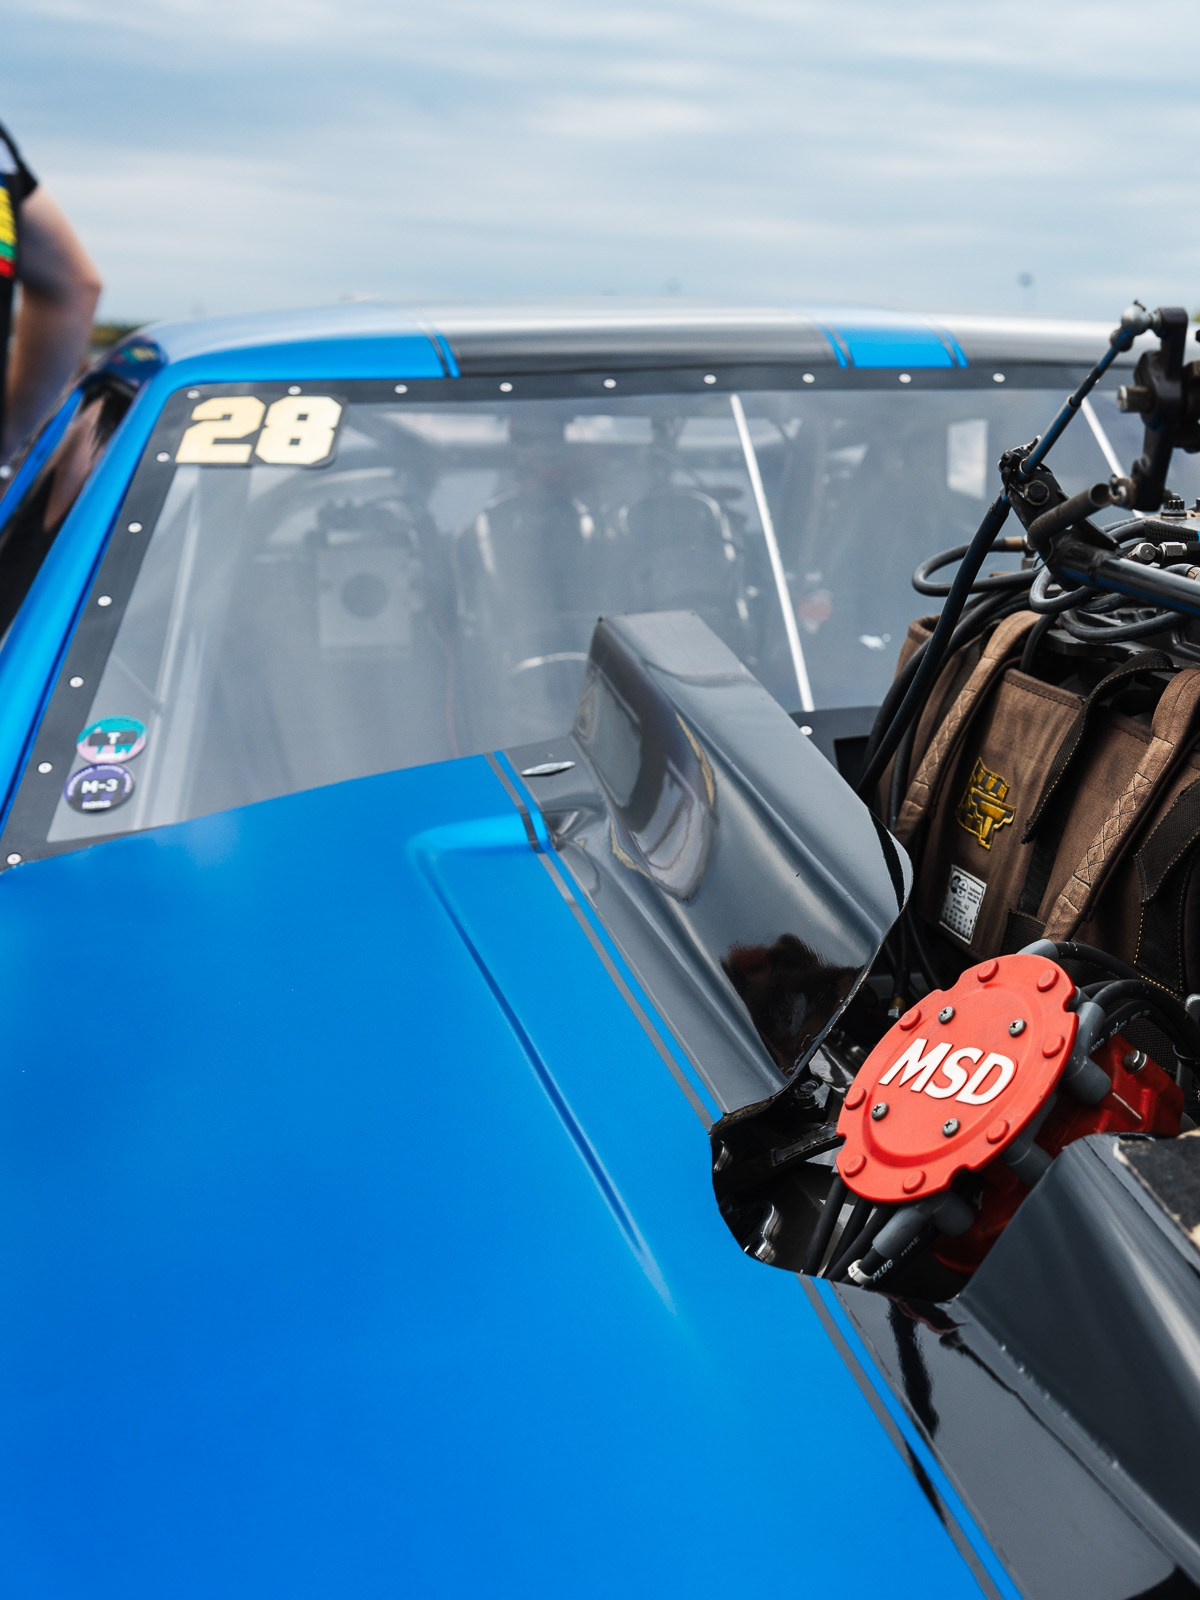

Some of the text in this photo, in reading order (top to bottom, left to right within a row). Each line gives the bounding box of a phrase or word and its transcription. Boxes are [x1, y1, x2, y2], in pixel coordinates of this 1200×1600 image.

[174, 395, 343, 466] 28
[107, 731, 121, 745] T
[81, 778, 118, 795] M-3
[879, 1037, 1015, 1106] MSD
[872, 1259, 894, 1282] PLUG
